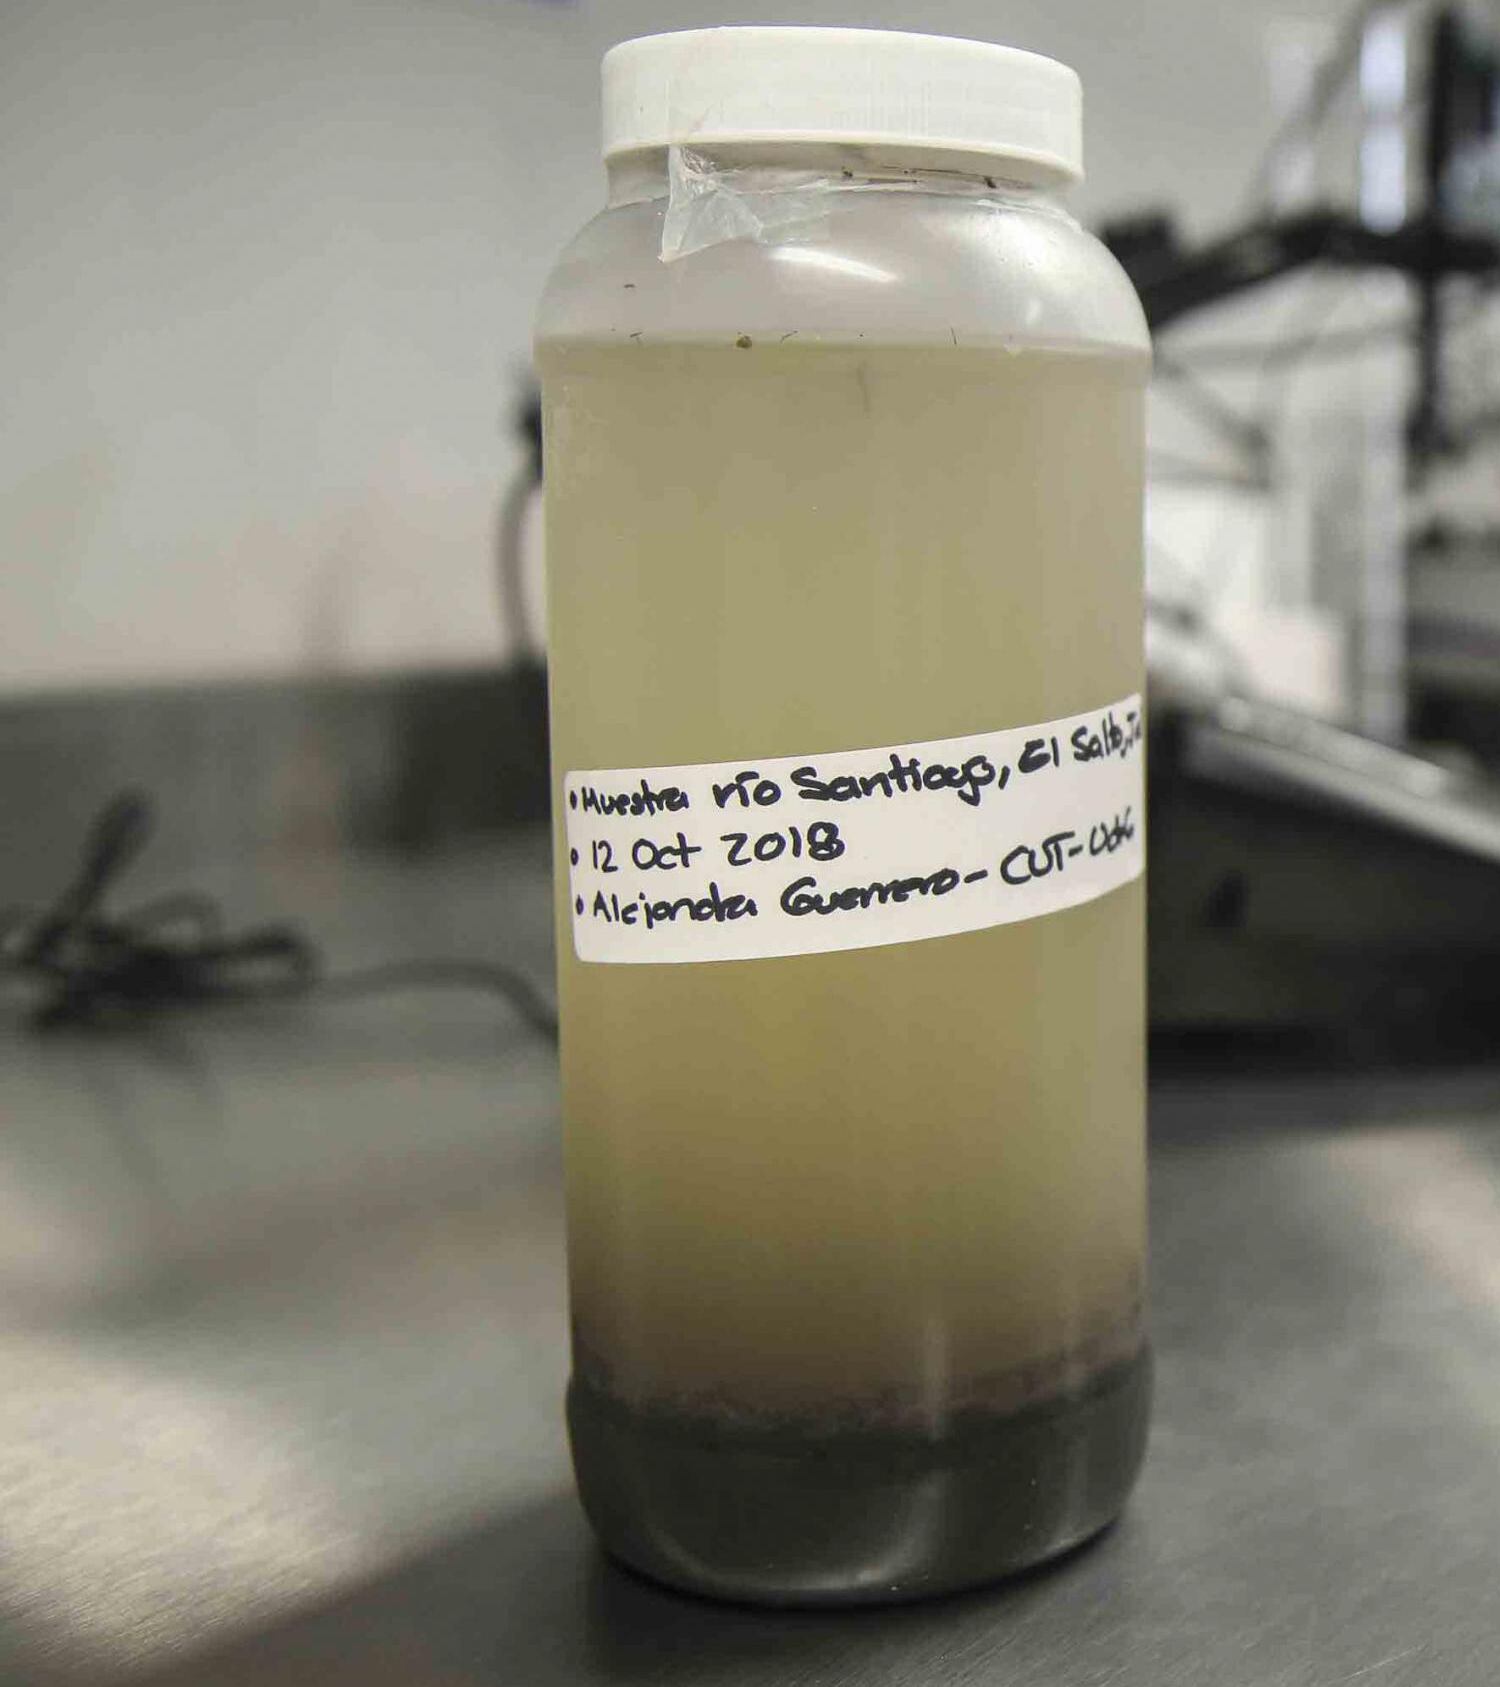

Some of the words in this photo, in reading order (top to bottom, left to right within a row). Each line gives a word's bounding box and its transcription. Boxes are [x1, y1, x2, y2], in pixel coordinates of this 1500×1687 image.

[581, 778, 690, 816] Muestra
[712, 771, 782, 808] río
[790, 753, 1011, 807] Santiago,
[1018, 736, 1060, 774] El
[592, 840, 618, 873] 12
[632, 832, 702, 870] Oct
[720, 821, 846, 867] 2018
[593, 881, 758, 930] Alejandra
